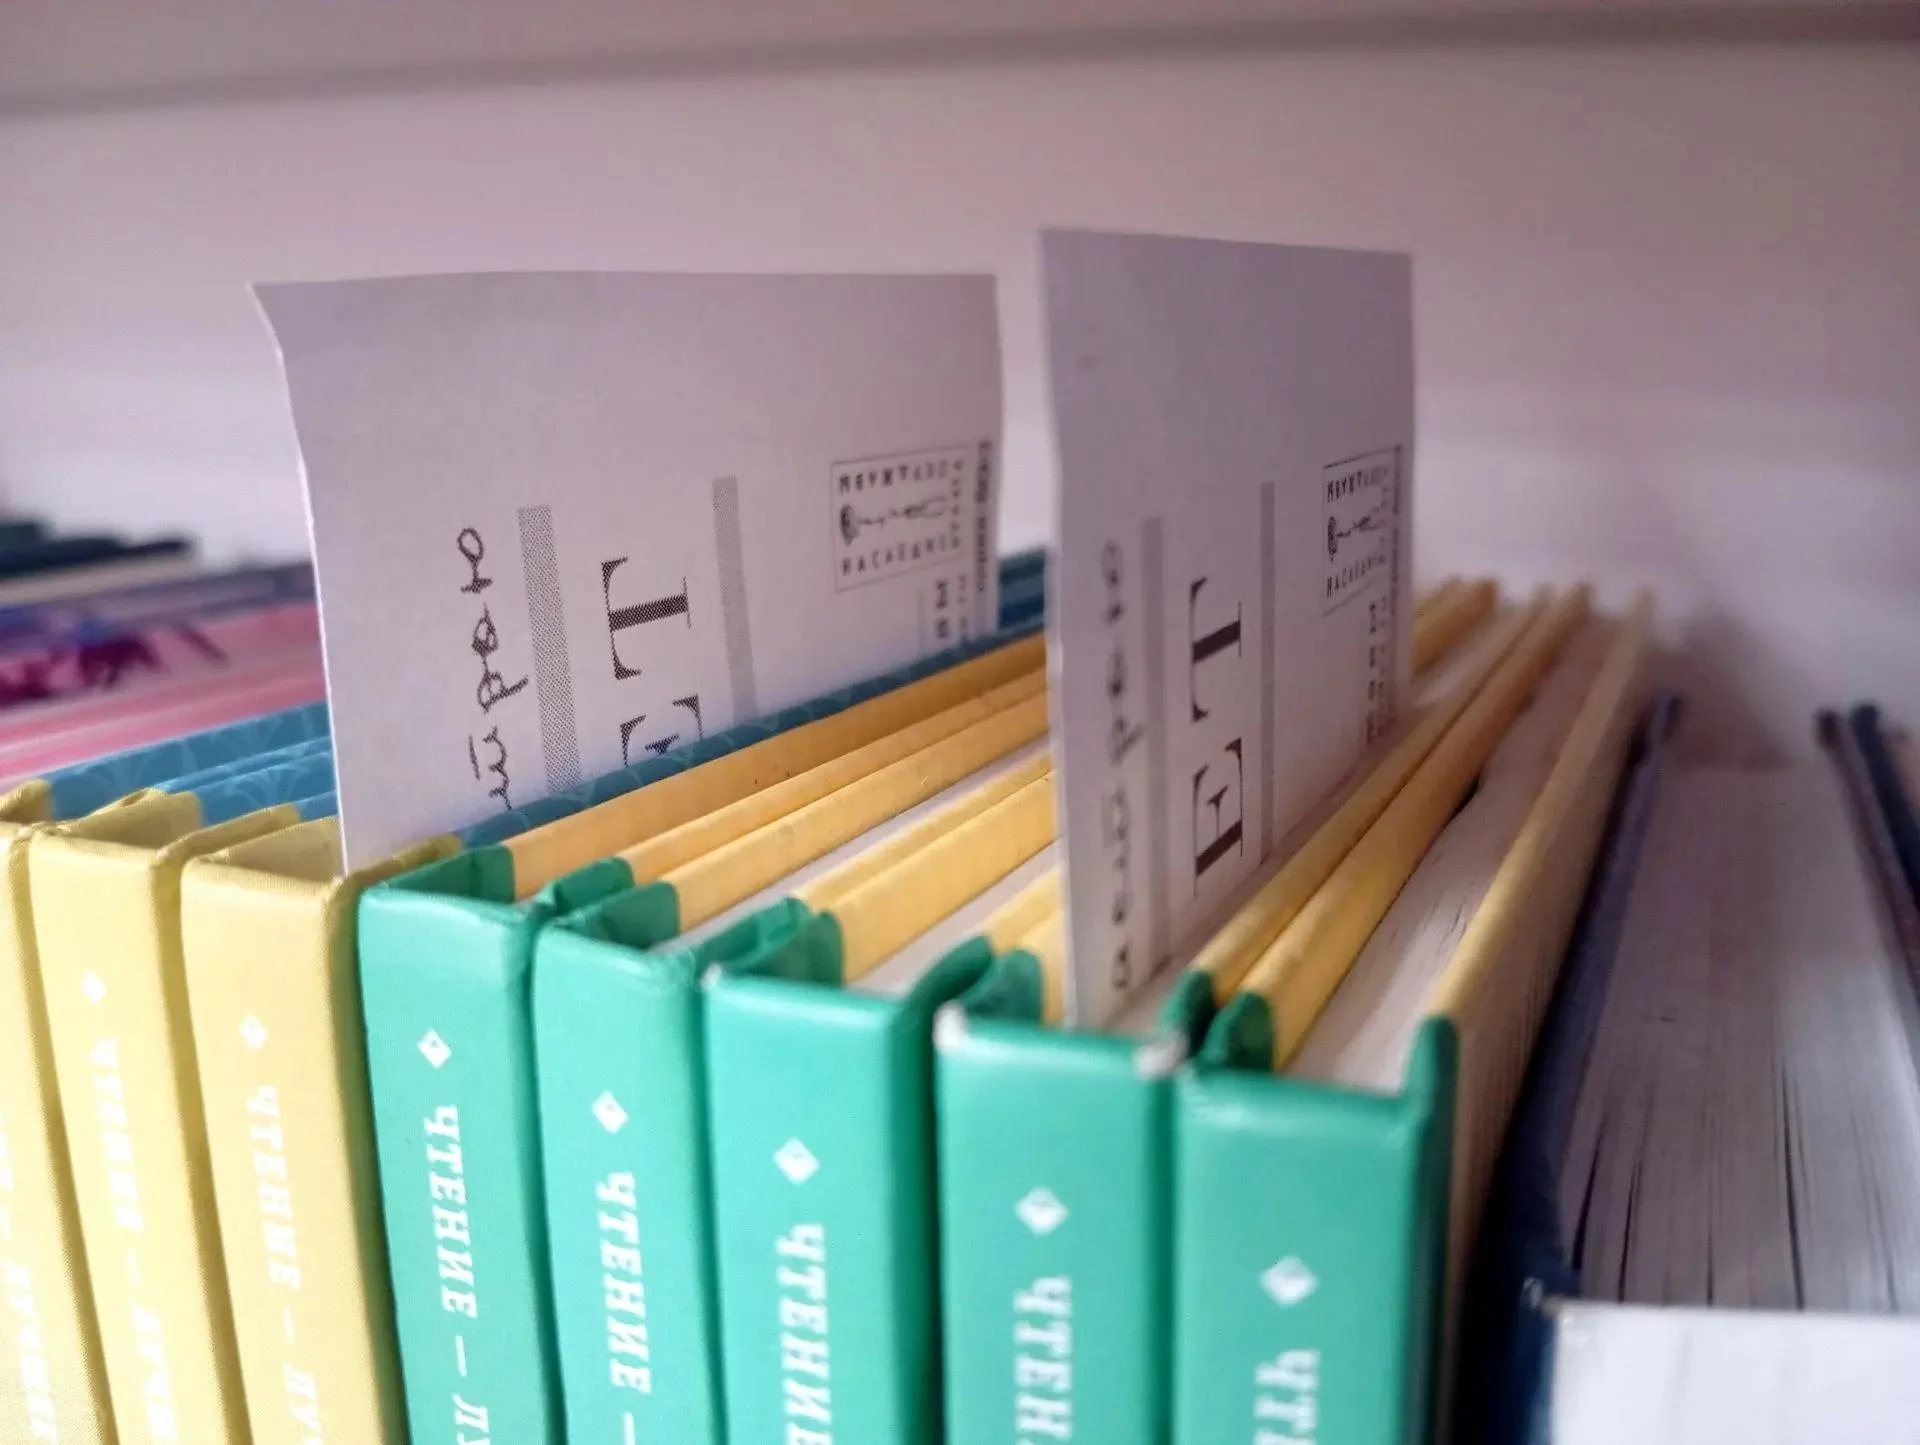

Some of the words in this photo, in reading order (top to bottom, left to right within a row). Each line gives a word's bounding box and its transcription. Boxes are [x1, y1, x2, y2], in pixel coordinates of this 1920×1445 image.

[247, 1085, 301, 1291] ЧТЕНИЕ
[424, 1104, 478, 1319] ЧТЕНИЕ
[595, 1171, 652, 1394] ЧТЕНИЕ
[775, 1222, 834, 1445] ЧТЕНИЕ
[1013, 1275, 1073, 1445] ЧТЕН
